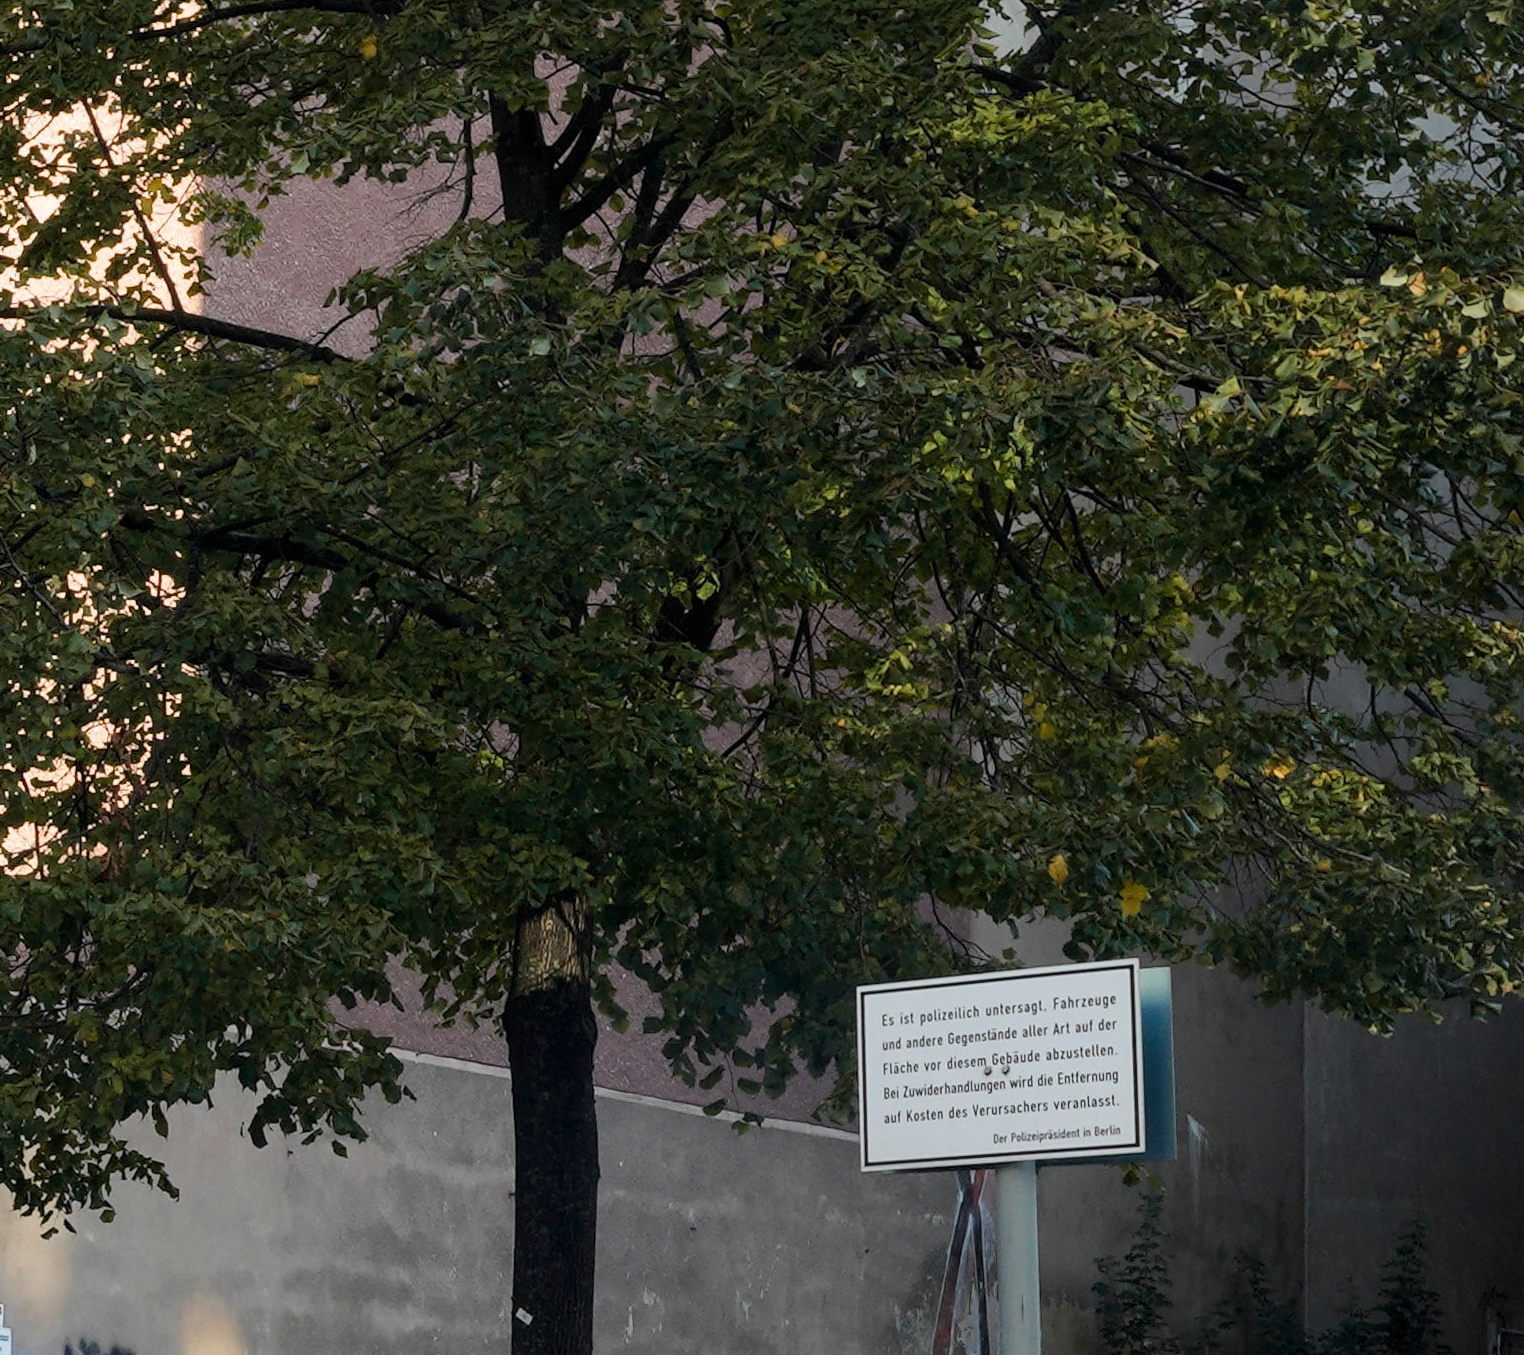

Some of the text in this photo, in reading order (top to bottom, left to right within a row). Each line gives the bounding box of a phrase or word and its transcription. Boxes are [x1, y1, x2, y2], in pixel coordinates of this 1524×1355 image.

[881, 1013, 895, 1027] Es
[899, 1012, 915, 1026] ist
[919, 1005, 980, 1027] polizeilich
[1052, 995, 1117, 1011] Fahrzeuge
[881, 1017, 1118, 1052] und andere Gegenstände aller Art auf der
[882, 1043, 1118, 1076] Fläche vor diesem Gebäude abzustellen.
[883, 1070, 1119, 1101] Bei Zuwiderhandlungen wird die Entfernung
[883, 1093, 1120, 1125] auf Kosten des Verursachers veranlasst.
[993, 1125, 1121, 1145] Der Polizeipräsident in Berlin
